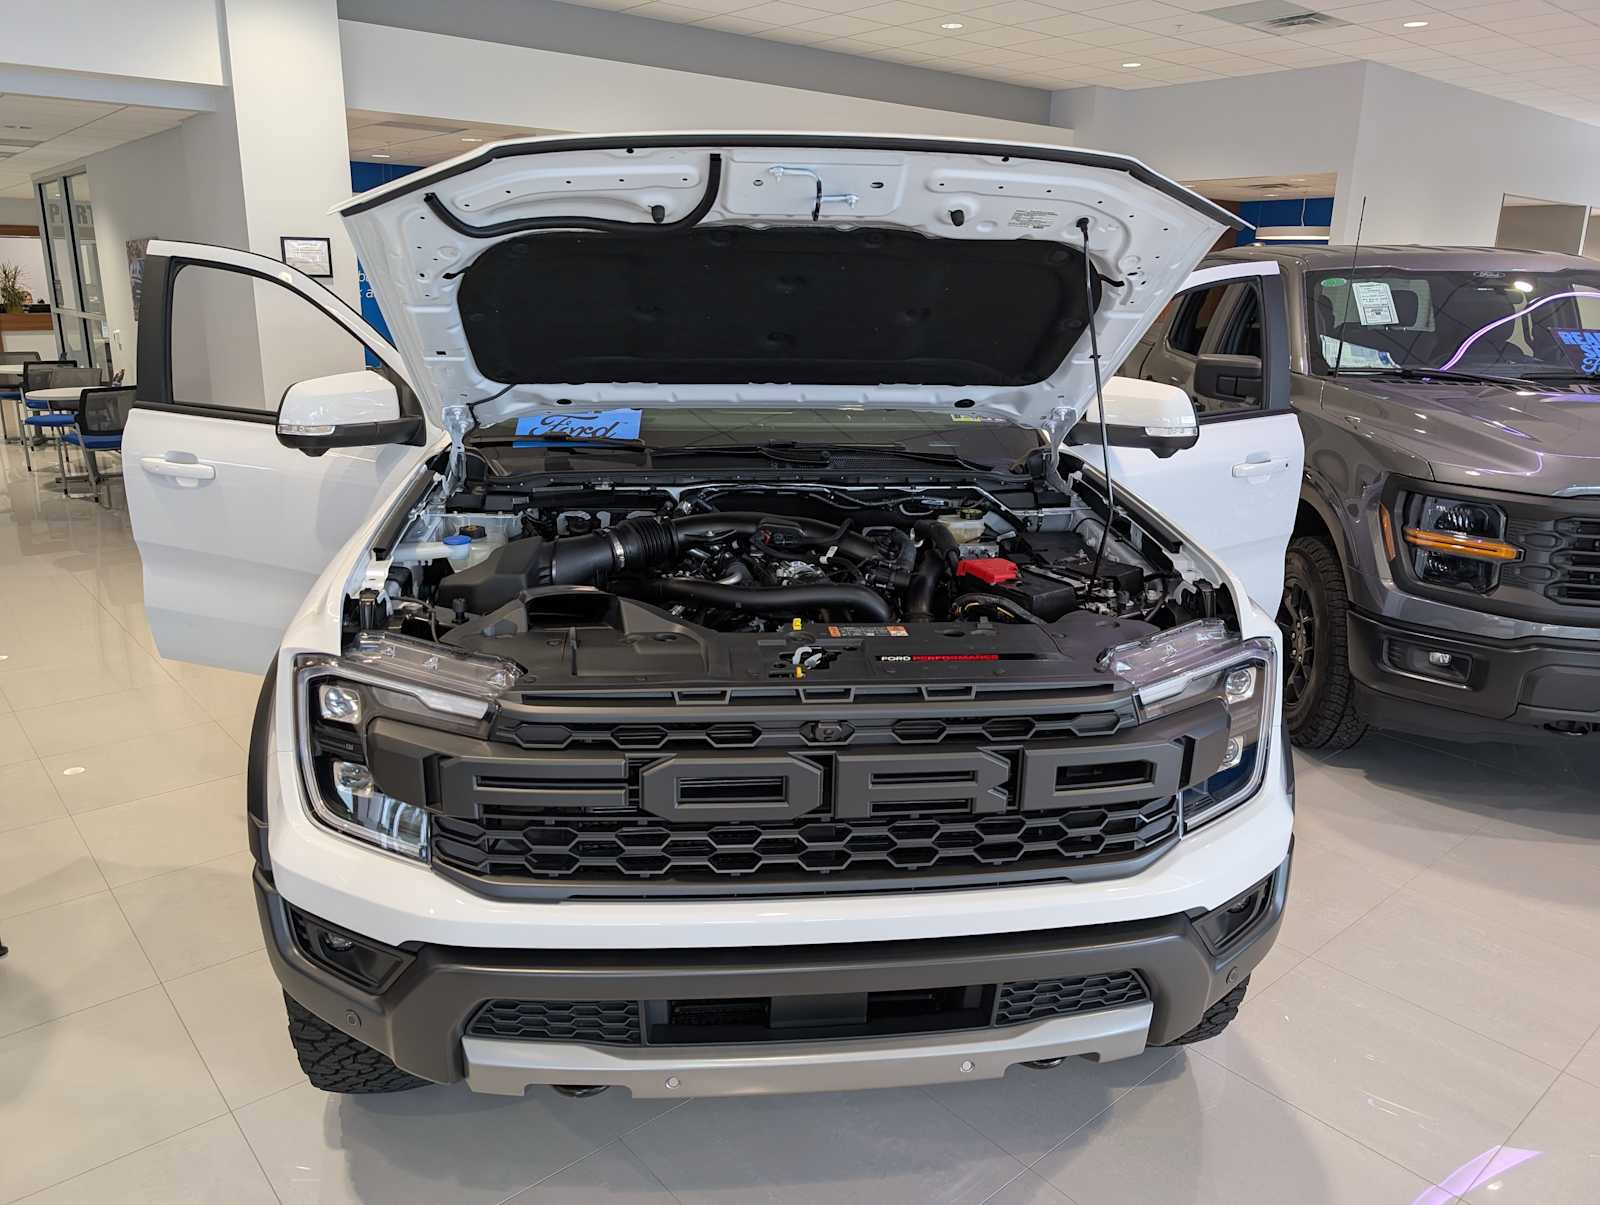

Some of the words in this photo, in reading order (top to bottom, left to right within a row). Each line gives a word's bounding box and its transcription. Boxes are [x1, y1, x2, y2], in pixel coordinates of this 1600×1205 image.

[528, 414, 620, 439] Ford
[911, 654, 999, 662] PERFORMANCE
[440, 740, 1183, 822] FORD
